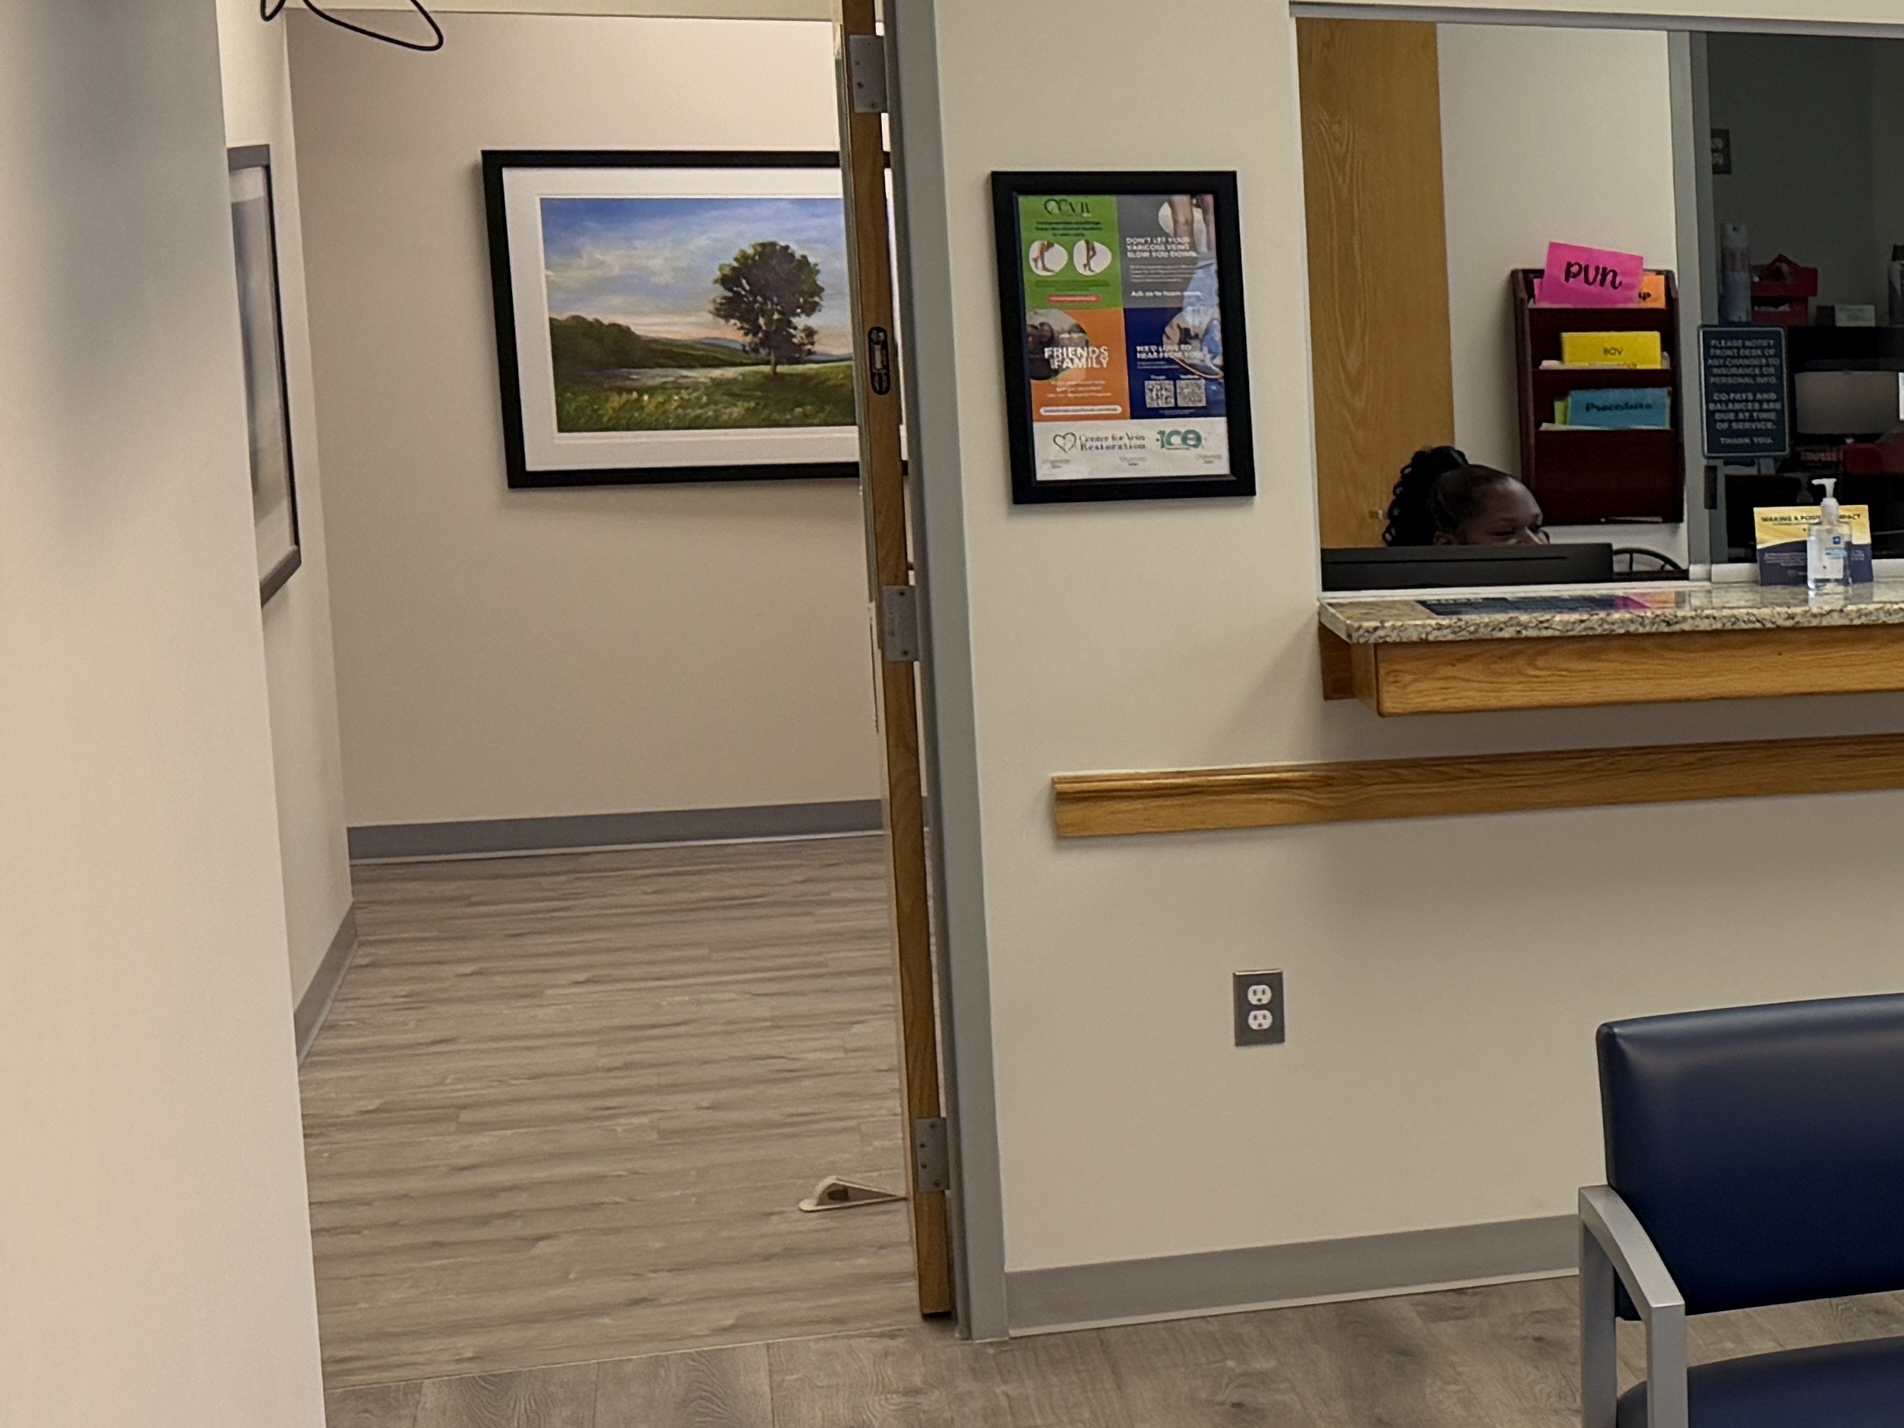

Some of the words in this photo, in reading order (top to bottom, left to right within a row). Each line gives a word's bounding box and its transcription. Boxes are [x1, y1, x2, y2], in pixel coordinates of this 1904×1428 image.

[1044, 346, 1108, 359] FRIENDS
[1055, 356, 1109, 369] FAMILY
[1080, 442, 1146, 452] Restoration
